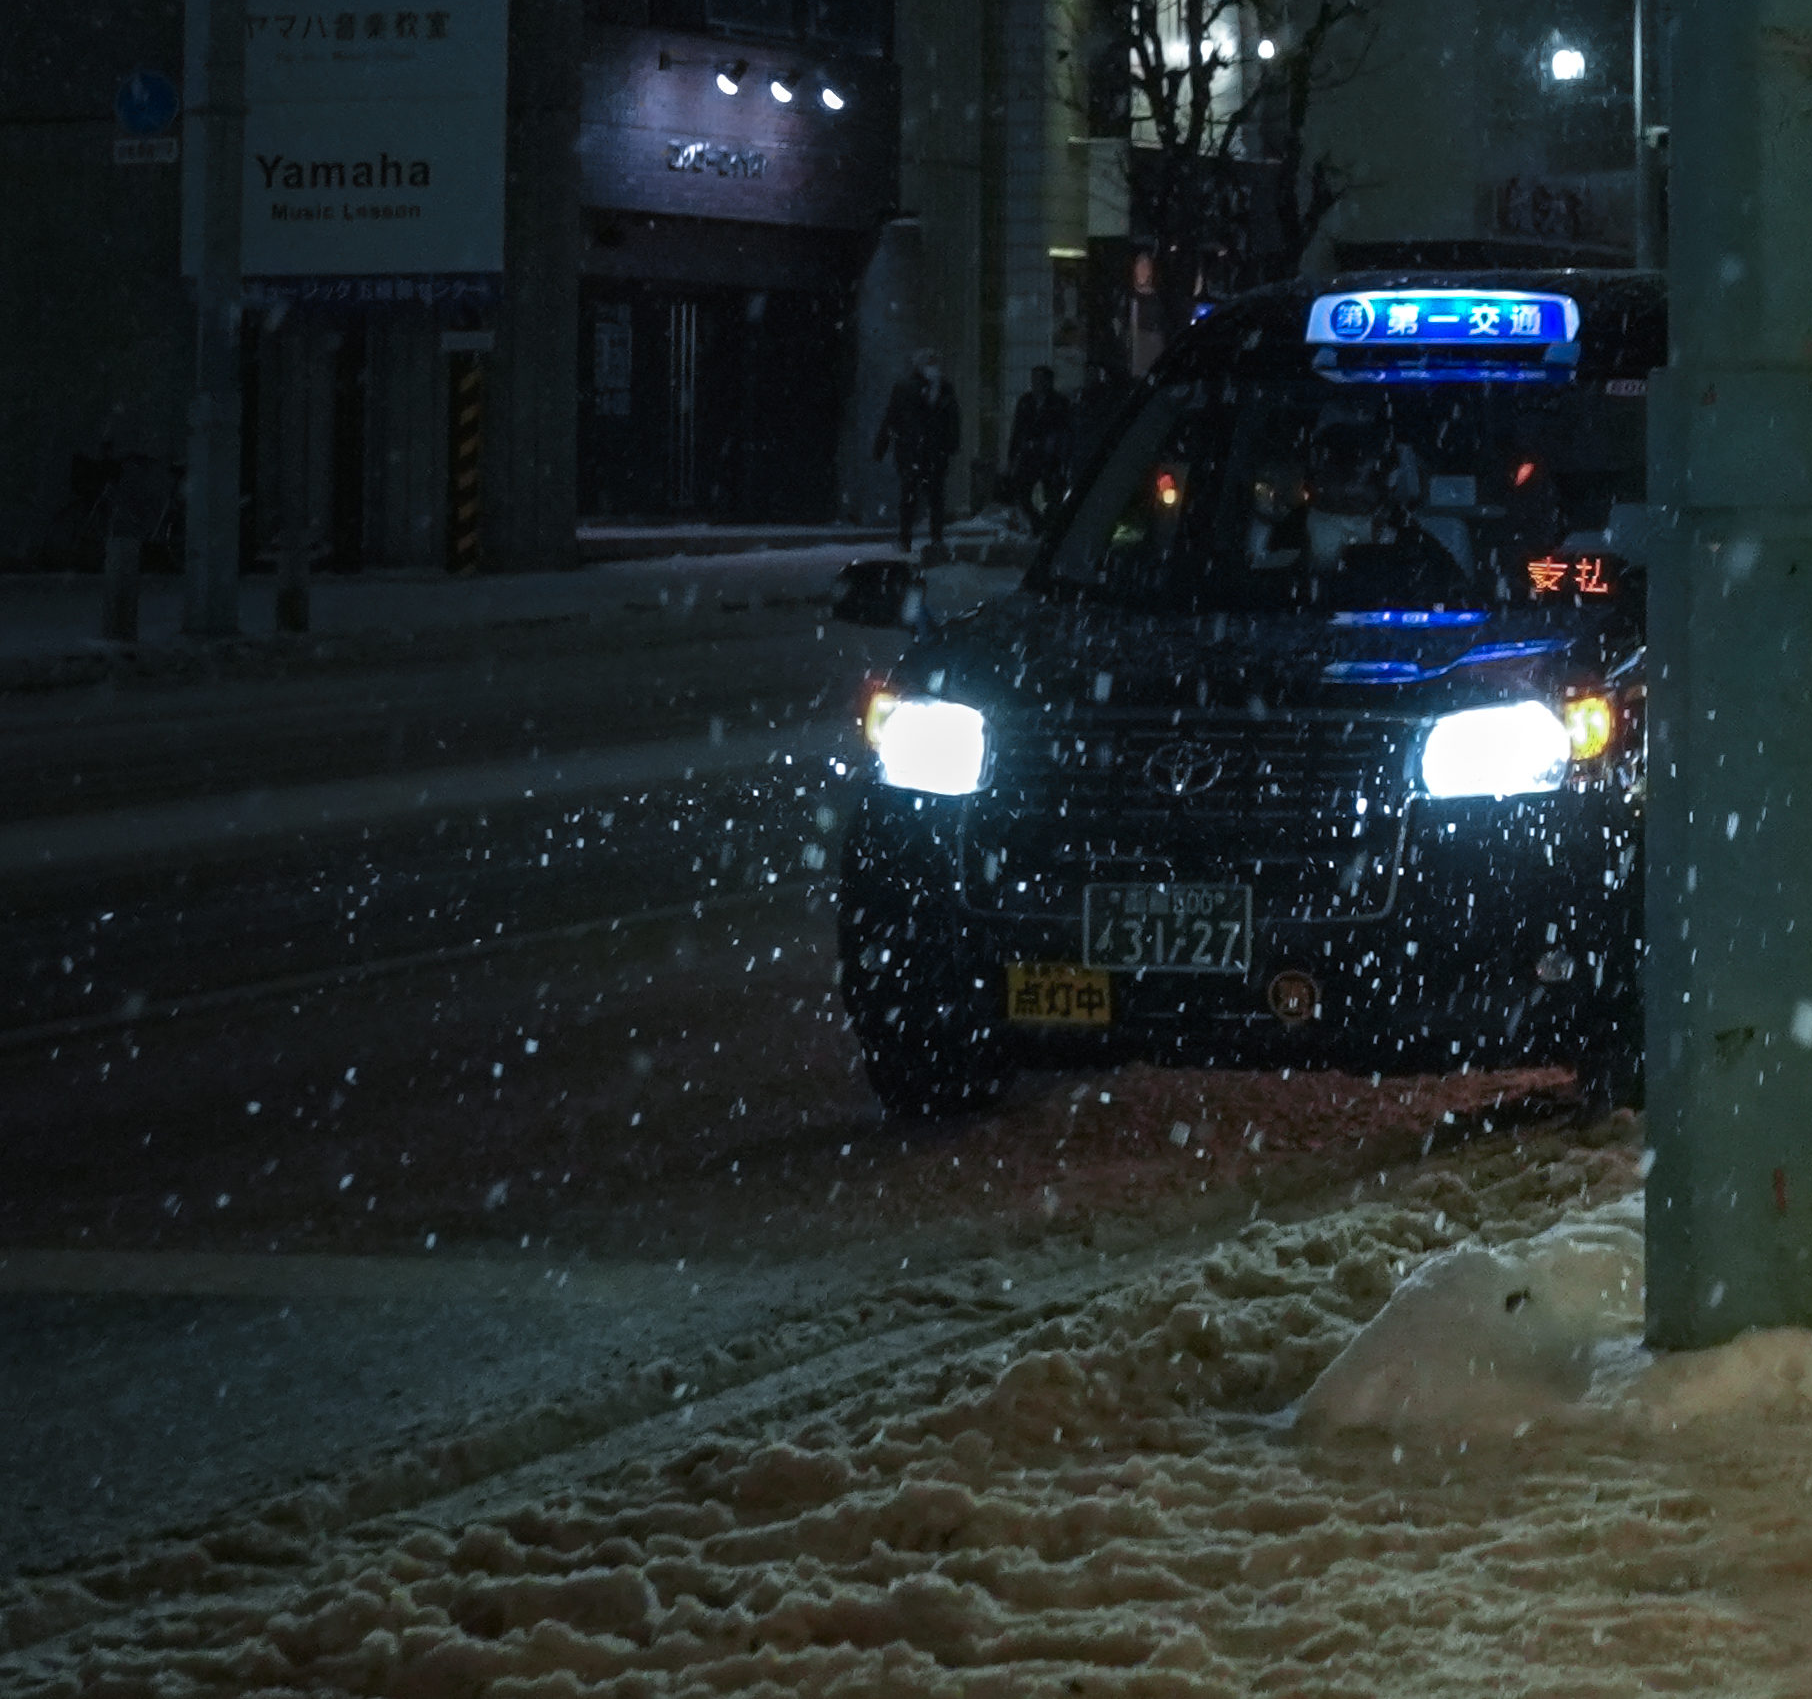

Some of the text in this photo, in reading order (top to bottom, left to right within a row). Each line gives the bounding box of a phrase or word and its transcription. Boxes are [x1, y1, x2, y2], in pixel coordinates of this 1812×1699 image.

[256, 153, 431, 188] Yamaha
[271, 203, 422, 221] Music Lesson
[1387, 303, 1541, 336] 第一交通
